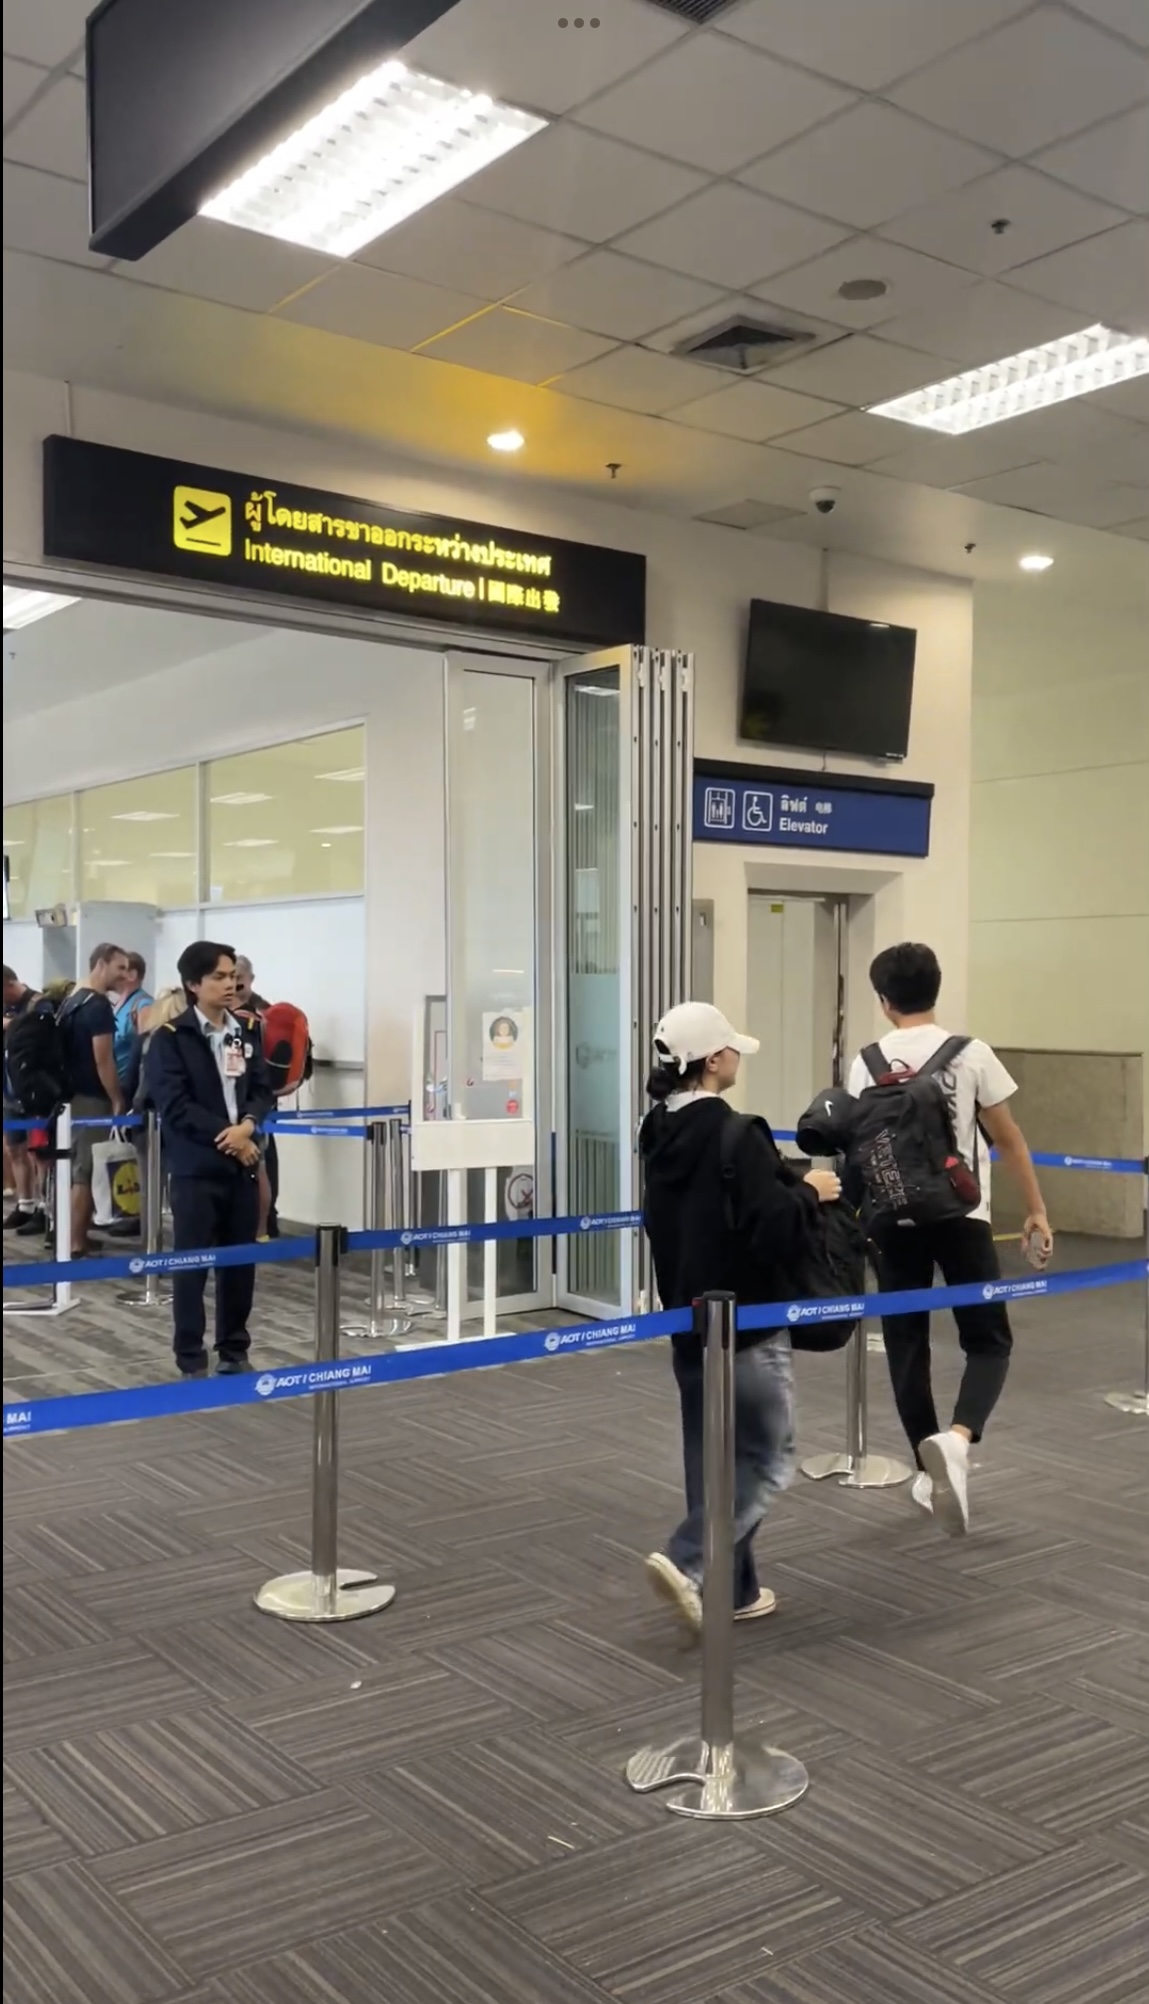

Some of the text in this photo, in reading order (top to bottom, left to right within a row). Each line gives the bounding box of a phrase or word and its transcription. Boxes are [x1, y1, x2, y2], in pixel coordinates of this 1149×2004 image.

[245, 491, 552, 577] ผู้โดยสารขาออกระหว่างประเทศ
[244, 538, 372, 581] International
[381, 561, 476, 599] Departure
[779, 816, 829, 835] Elevator
[560, 1332, 581, 1345] AOT
[586, 1326, 620, 1341] CHIANG
[620, 1323, 637, 1335] MAI
[275, 1374, 302, 1388] AOT
[308, 1367, 351, 1383] CHIANG
[351, 1364, 372, 1378] MAI
[6, 1410, 32, 1425] MAI
